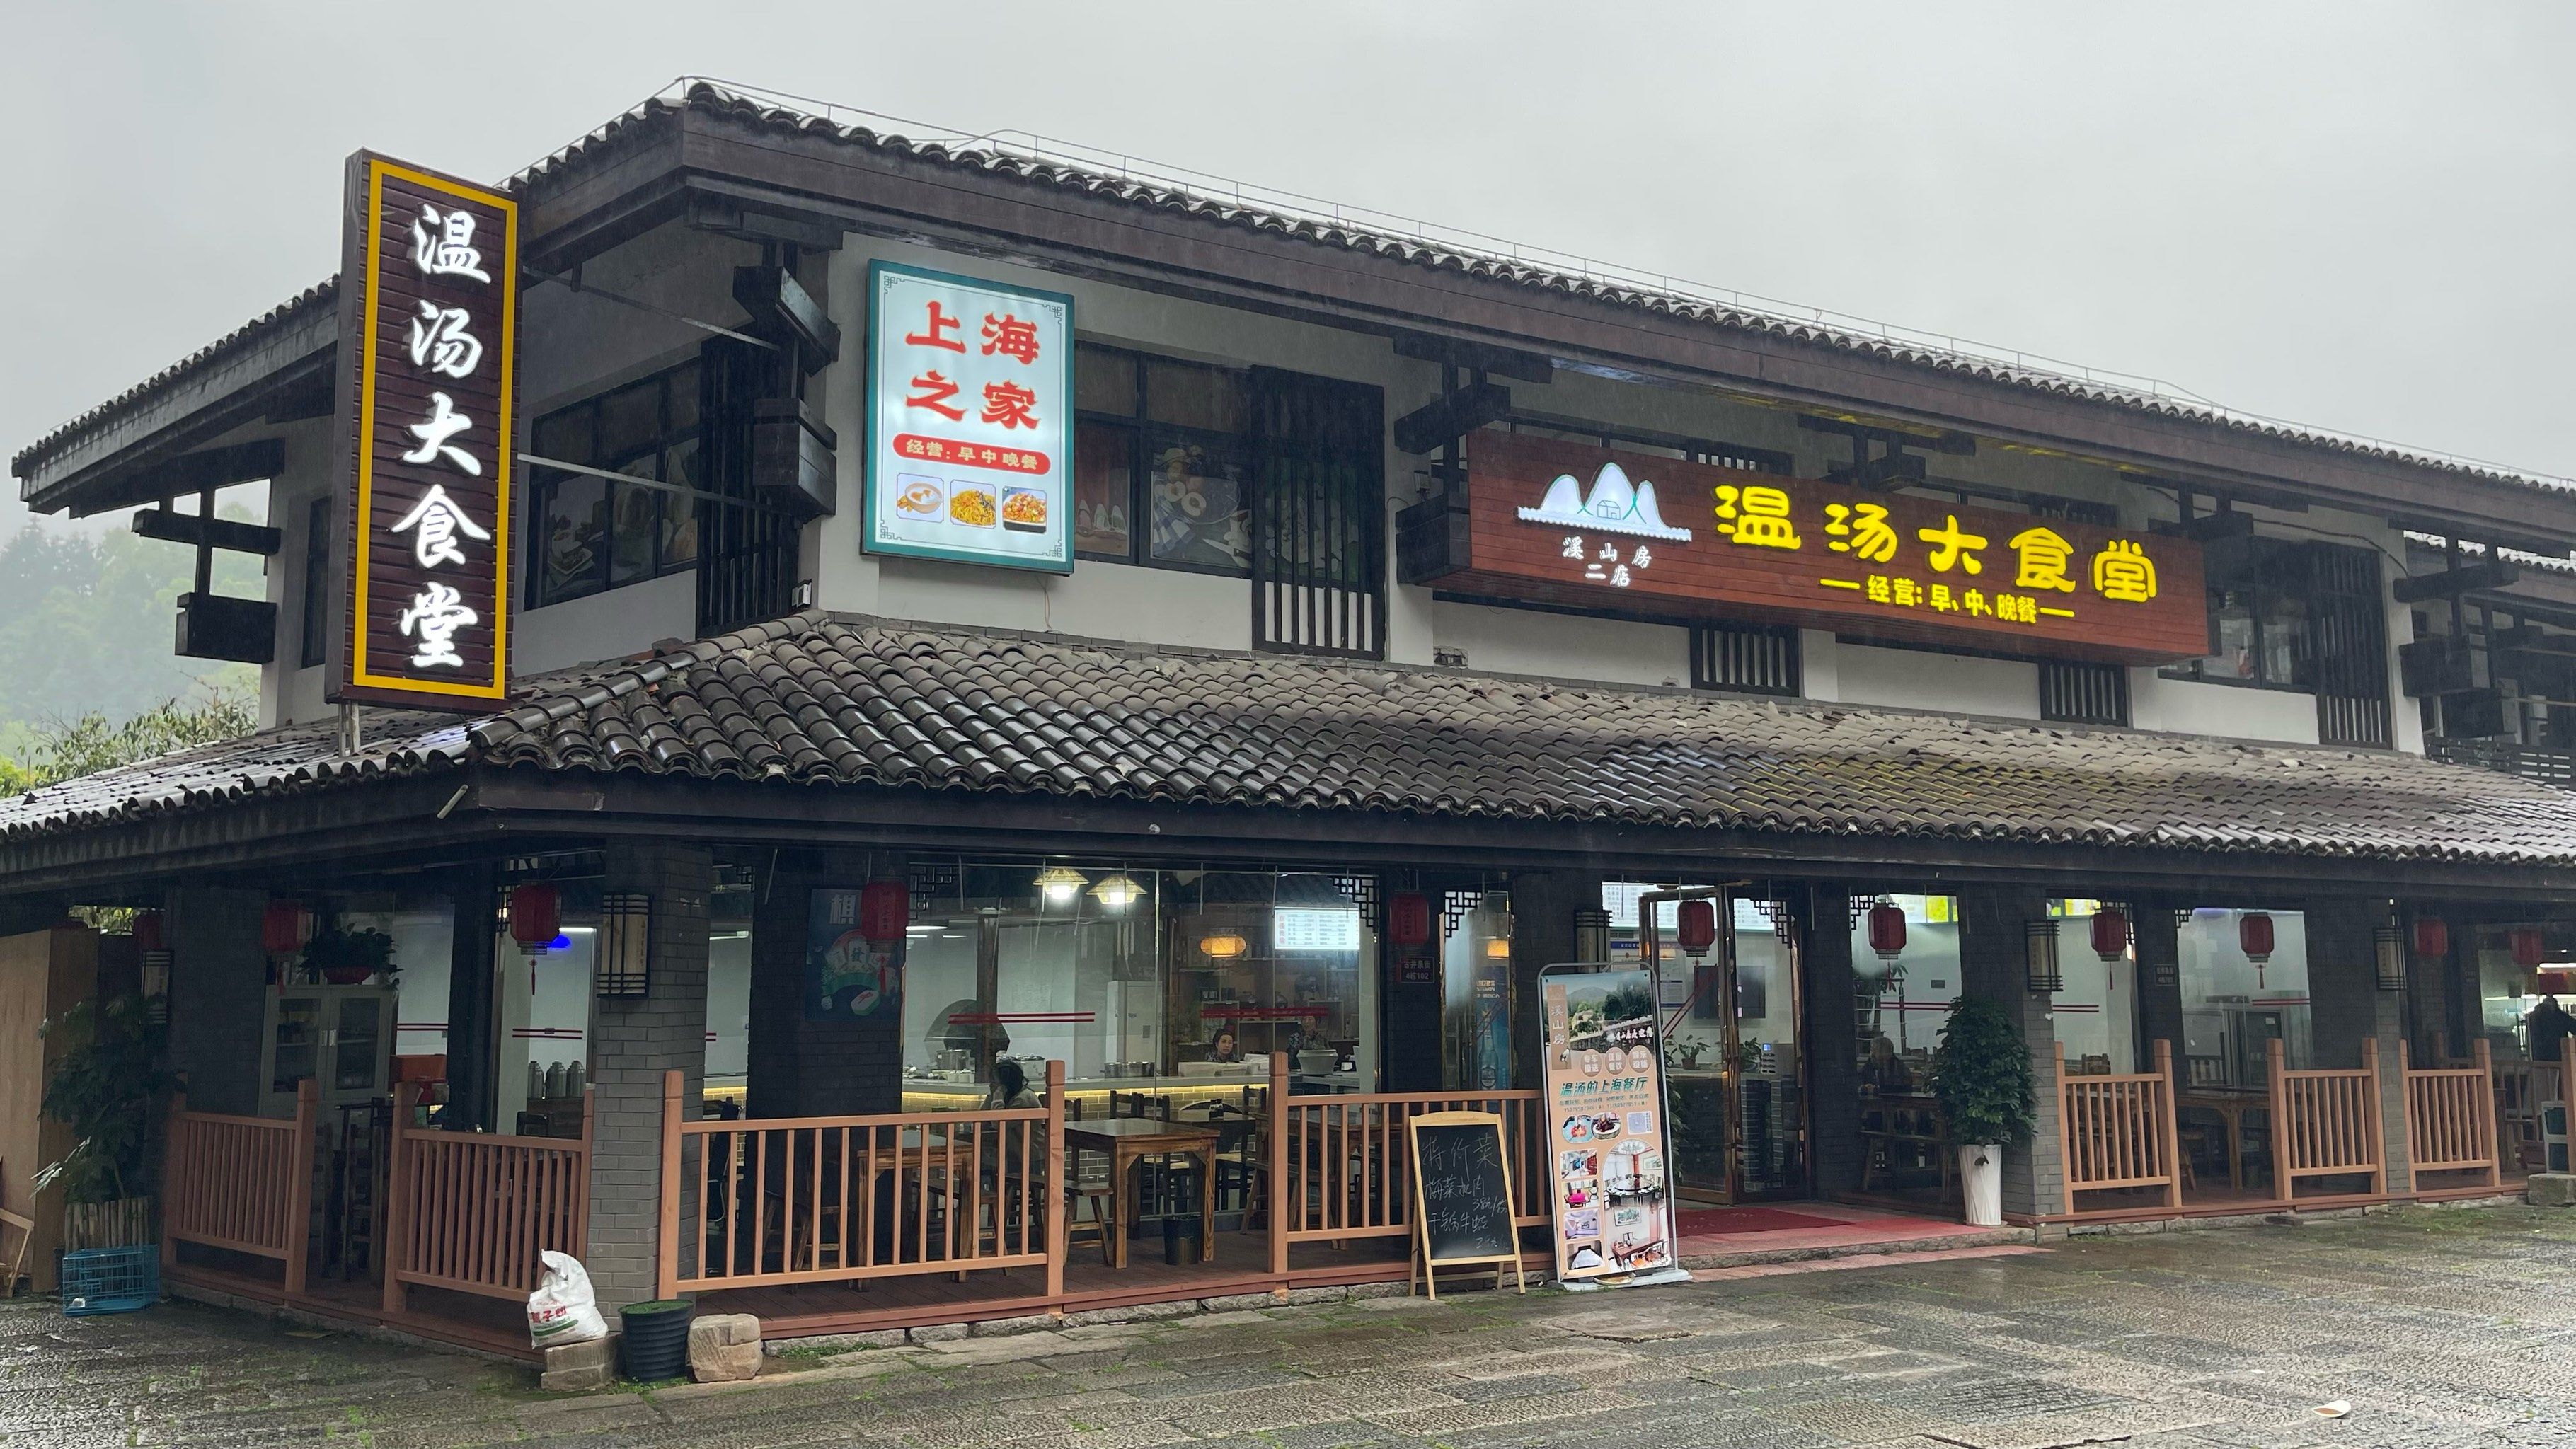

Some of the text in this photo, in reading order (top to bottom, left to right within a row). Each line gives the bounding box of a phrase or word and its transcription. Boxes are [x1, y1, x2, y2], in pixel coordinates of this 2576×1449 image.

[904, 300, 1041, 366] 上海
[904, 369, 1042, 430] 之家
[391, 202, 492, 668] 温汤大食堂
[1562, 536, 1652, 570] 溪山房
[1713, 485, 2157, 603] 温汤大食堂
[1585, 564, 1631, 587] 二店
[1551, 1005, 1566, 1045] 溪山房
[1560, 1077, 1648, 1097] 温汤的上海餐厅
